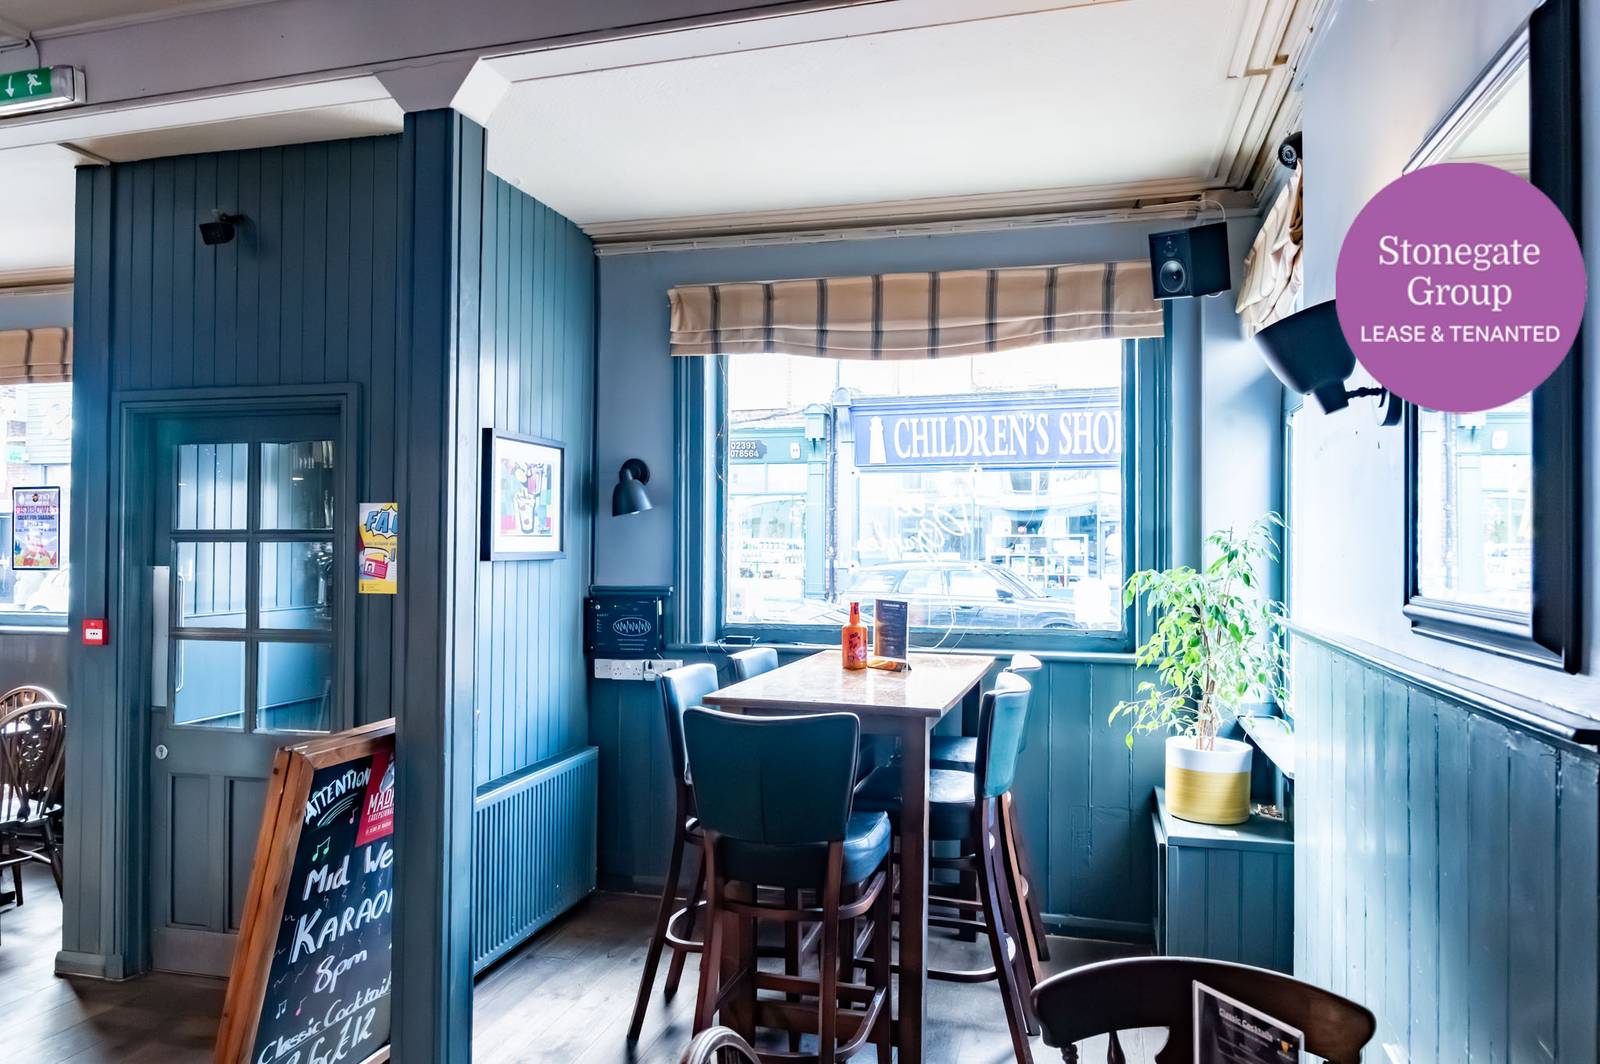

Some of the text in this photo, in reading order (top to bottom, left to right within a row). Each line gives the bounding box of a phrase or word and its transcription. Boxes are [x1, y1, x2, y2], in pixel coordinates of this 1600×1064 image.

[730, 441, 757, 450] 02393
[730, 449, 760, 458] 078564
[893, 411, 1049, 459] CHILDREN'S
[305, 768, 370, 825] ATTENTION
[312, 950, 367, 994] 8pm
[257, 1017, 322, 1064] Classic
